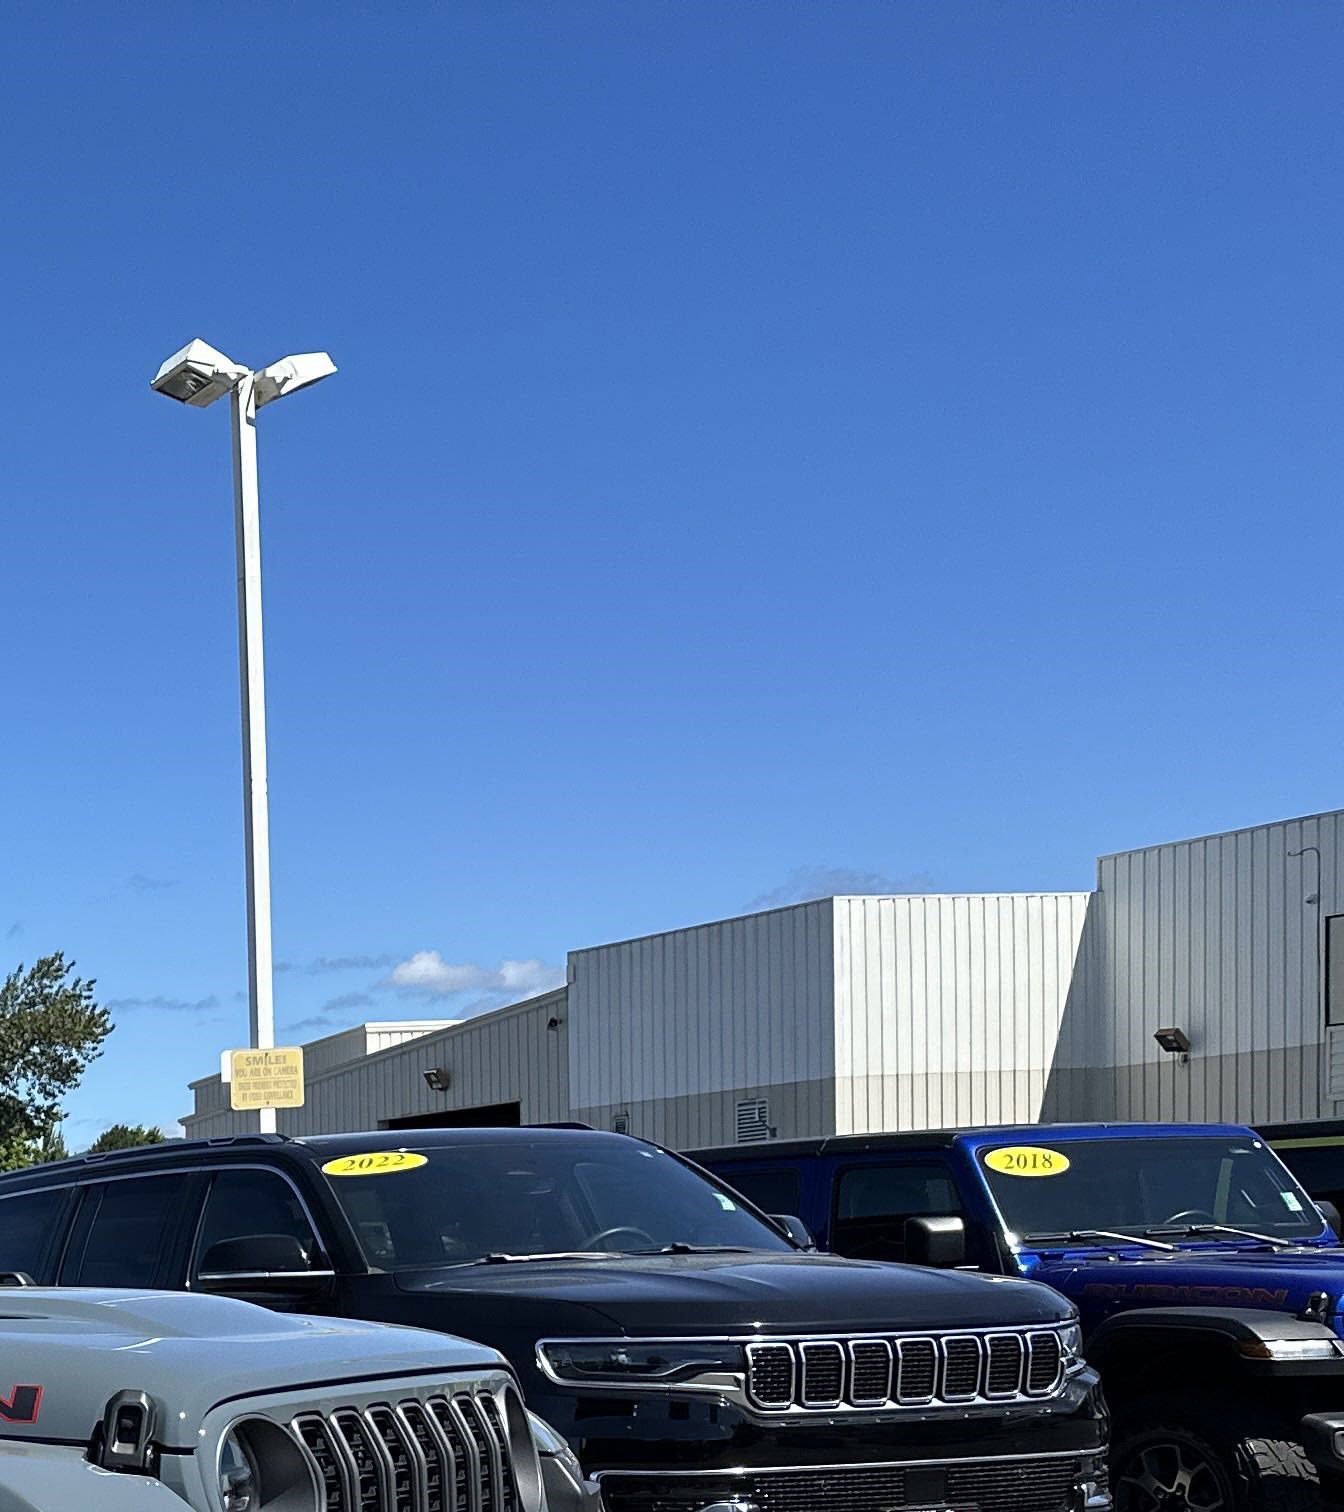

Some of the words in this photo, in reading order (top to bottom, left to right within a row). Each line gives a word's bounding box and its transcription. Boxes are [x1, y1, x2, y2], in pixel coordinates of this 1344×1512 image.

[342, 1154, 406, 1172] 2022
[1003, 1153, 1053, 1169] 2018
[1082, 1283, 1289, 1304] RUBICON
